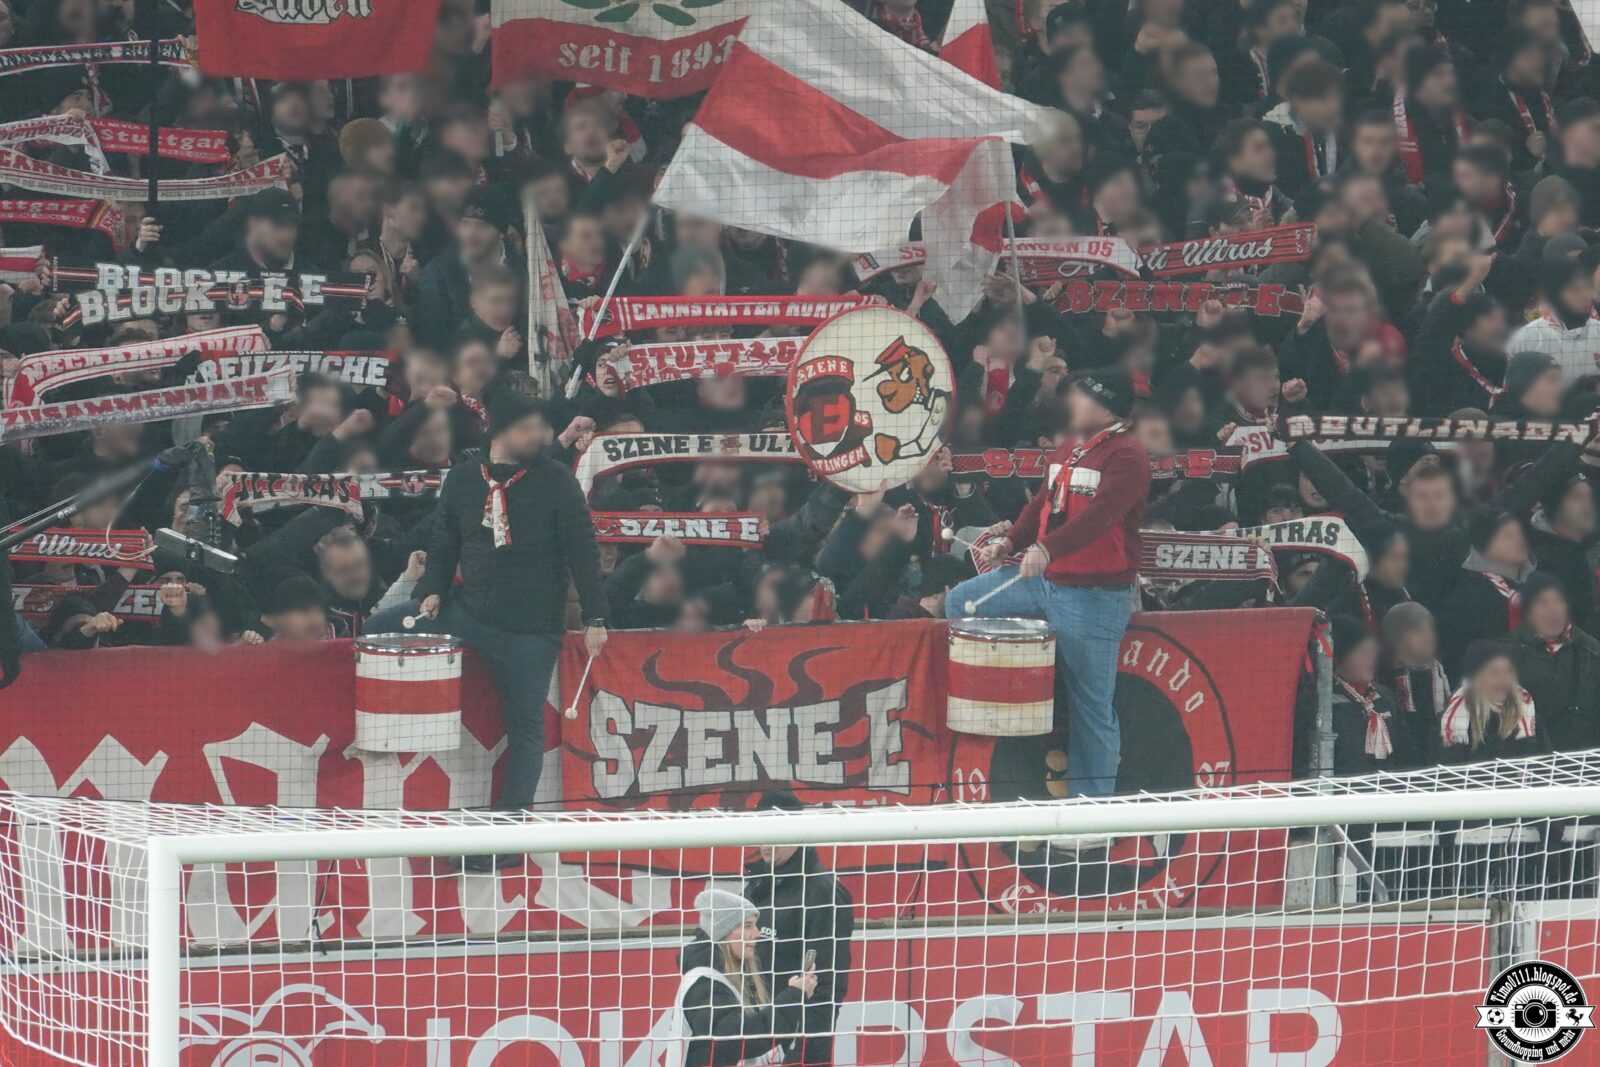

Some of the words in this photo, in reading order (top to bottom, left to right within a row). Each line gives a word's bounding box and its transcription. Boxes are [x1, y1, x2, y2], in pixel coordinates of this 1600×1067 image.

[558, 38, 632, 75] seit
[101, 129, 227, 151] Stutgar
[1088, 240, 1114, 257] 05
[1182, 238, 1273, 267] Ultras
[77, 283, 215, 325] BLOCK
[262, 278, 288, 311] E
[300, 275, 326, 304] E
[797, 359, 848, 383] SZENE
[1287, 414, 1591, 446] REUTLINGEN
[603, 435, 690, 462] SZENE
[697, 436, 713, 453] E
[813, 446, 864, 471] TLINGEN
[620, 517, 731, 541] SZENE
[739, 517, 760, 541] E
[1156, 544, 1249, 570] SZENE
[590, 689, 849, 797] SZENE
[867, 677, 911, 795] E
[954, 767, 987, 801] 19
